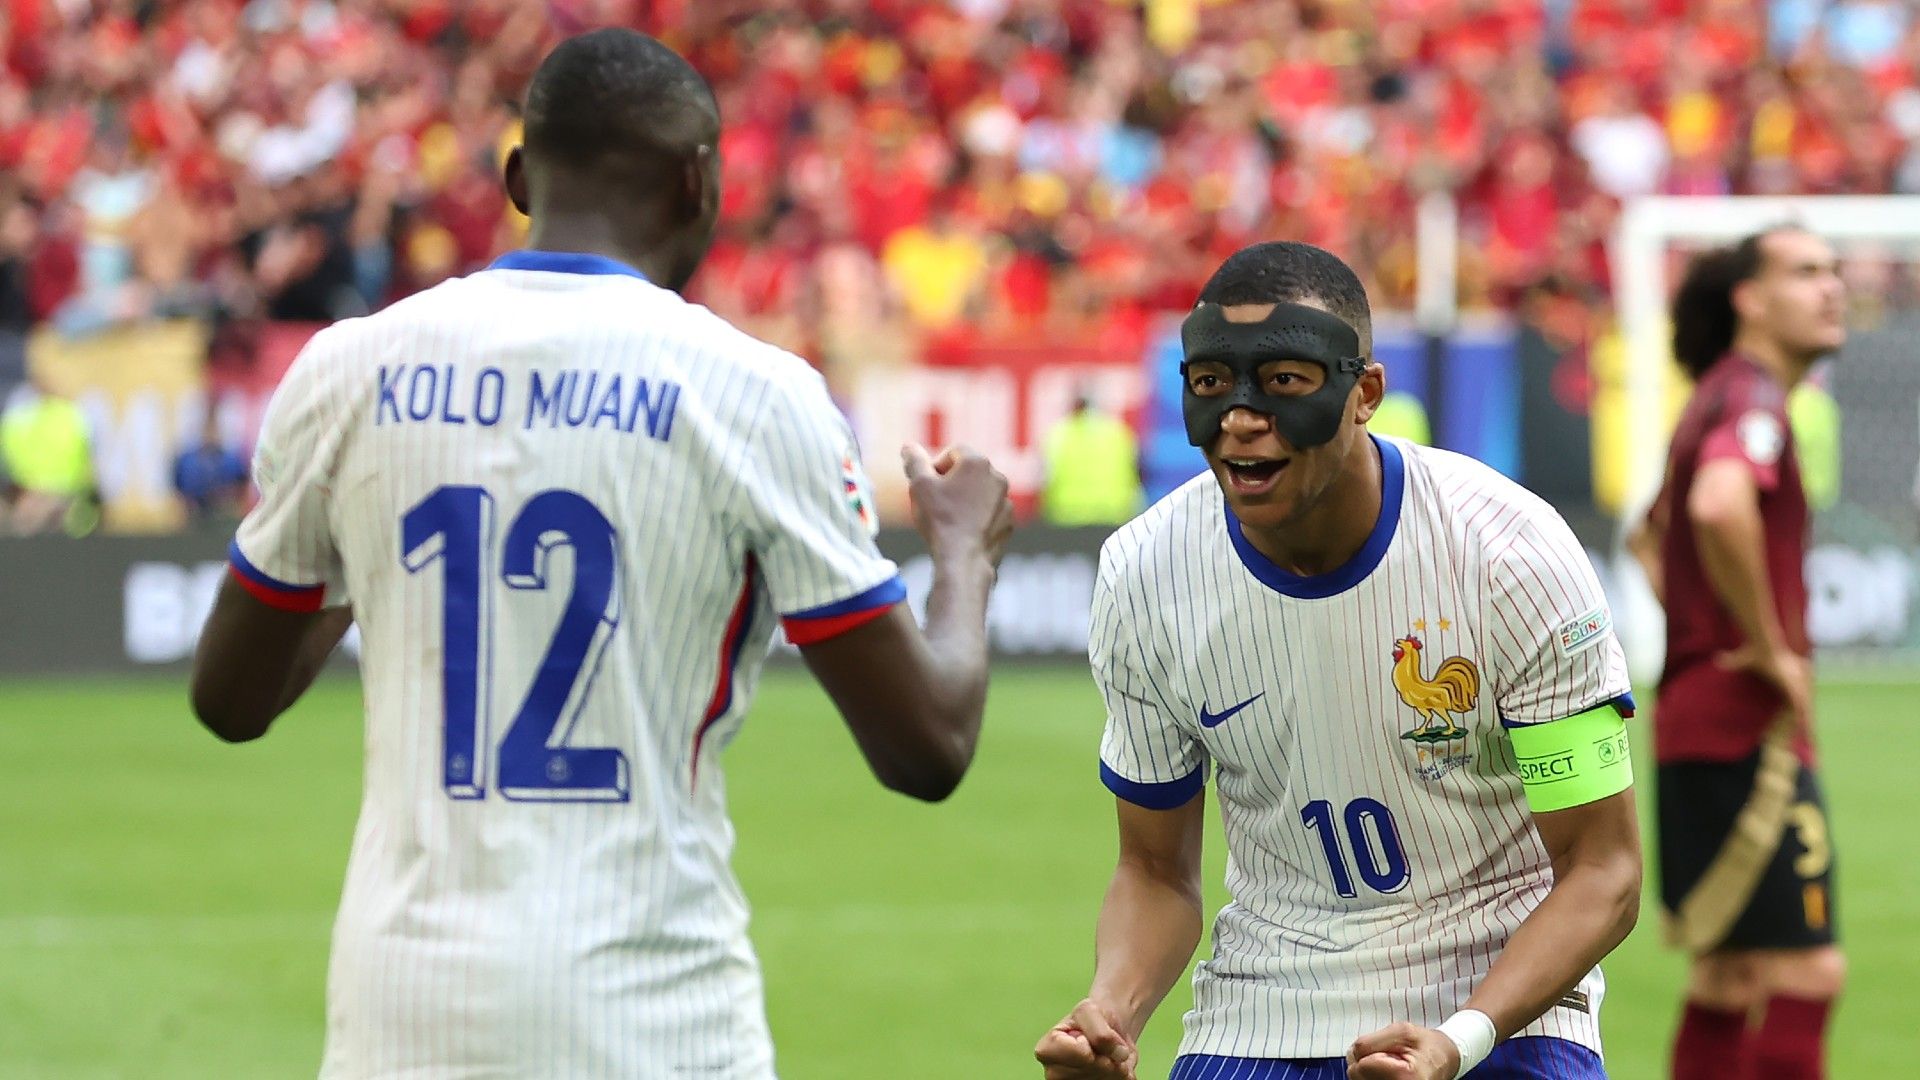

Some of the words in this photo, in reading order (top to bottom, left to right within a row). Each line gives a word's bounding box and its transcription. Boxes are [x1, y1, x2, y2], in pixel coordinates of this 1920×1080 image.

[376, 363, 504, 427] KOLO
[522, 368, 682, 443] MUANI
[399, 484, 630, 803] 12
[1300, 797, 1412, 899] 10
